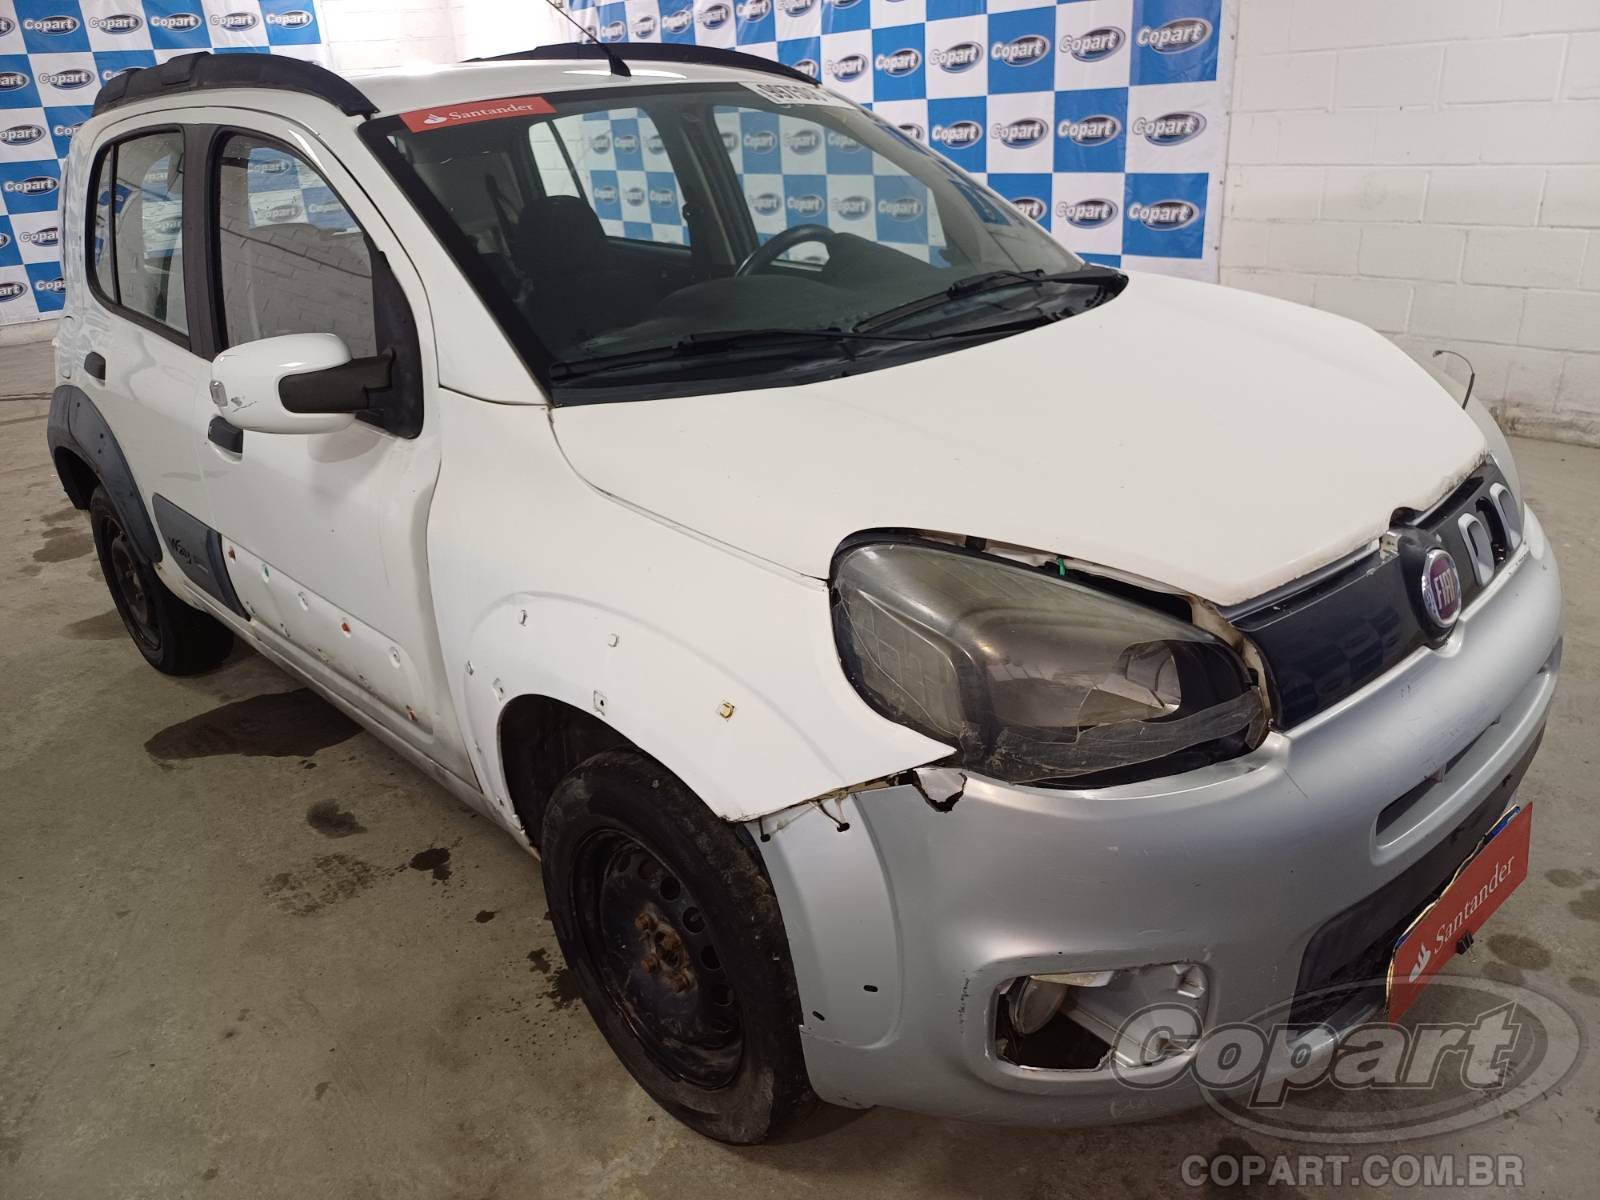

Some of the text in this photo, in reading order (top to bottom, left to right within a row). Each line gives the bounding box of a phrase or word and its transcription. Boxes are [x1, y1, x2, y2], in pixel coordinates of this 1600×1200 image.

[24, 19, 74, 32] Copart
[89, 17, 136, 30] Copart
[151, 14, 196, 30] Copart
[211, 14, 253, 29] Copart
[266, 12, 308, 27] Copart
[1060, 32, 1118, 54] Copart
[1137, 24, 1202, 48] Copart
[930, 47, 977, 67] Copart
[991, 39, 1043, 61] Copart
[876, 53, 916, 72] Copart
[0, 74, 23, 86] art
[39, 72, 88, 87] Copart
[449, 102, 535, 121] Santander
[0, 128, 37, 142] opart
[932, 122, 978, 145] Copart
[991, 120, 1042, 144] Copart
[1058, 117, 1114, 142] Copart
[1133, 114, 1197, 141] Copart
[4, 178, 54, 193] Copart
[1056, 200, 1112, 223] Copart
[1129, 202, 1192, 227] Copart
[20, 231, 58, 244] Copa
[0, 285, 20, 296] art
[35, 279, 65, 293] Cop
[1433, 567, 1456, 610] FIAT
[1434, 855, 1516, 954] Santander
